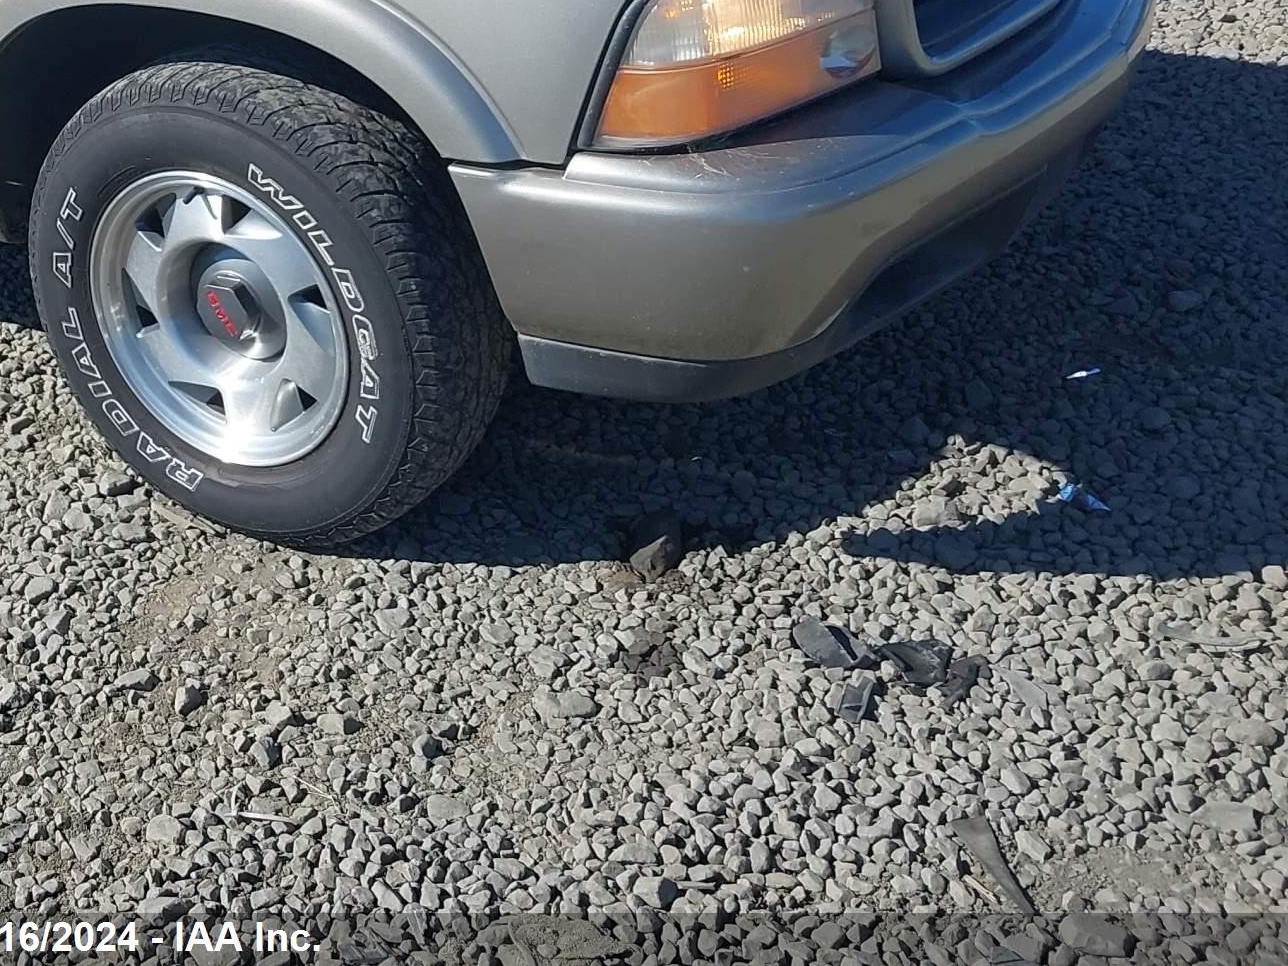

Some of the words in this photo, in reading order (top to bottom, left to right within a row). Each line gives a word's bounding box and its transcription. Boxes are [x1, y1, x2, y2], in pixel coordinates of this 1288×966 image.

[53, 187, 83, 288] A/T
[247, 163, 380, 444] WILDCAT
[62, 307, 204, 491] RADIAL
